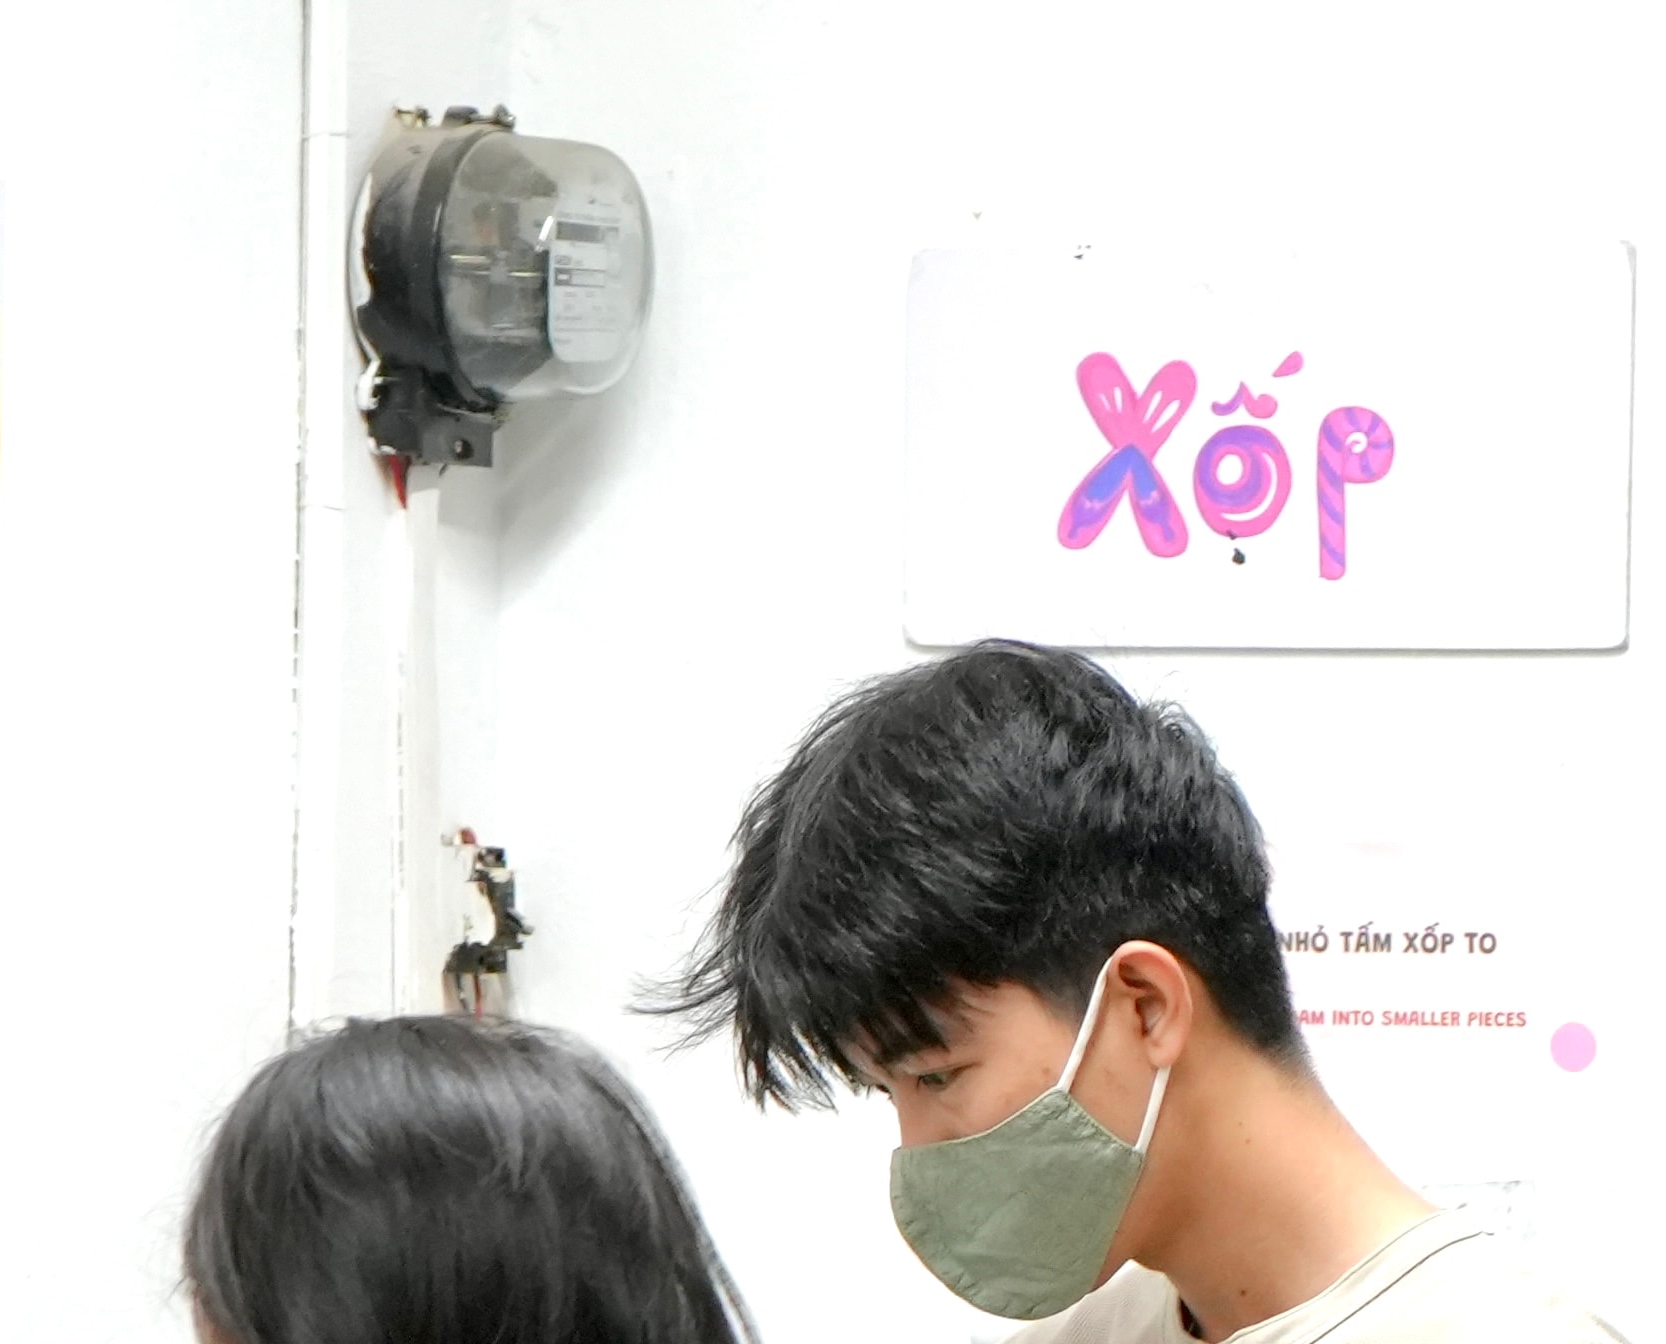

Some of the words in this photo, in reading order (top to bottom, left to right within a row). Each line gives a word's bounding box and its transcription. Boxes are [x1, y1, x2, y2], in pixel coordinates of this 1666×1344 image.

[1057, 350, 1395, 581] Xốp
[1340, 921, 1392, 953] TẤM
[1403, 922, 1455, 954] XỐP
[1465, 932, 1497, 954] TO
[1332, 1010, 1375, 1026] INTO
[1381, 1010, 1461, 1026] SMALLER
[1467, 1012, 1527, 1027] PIECES
